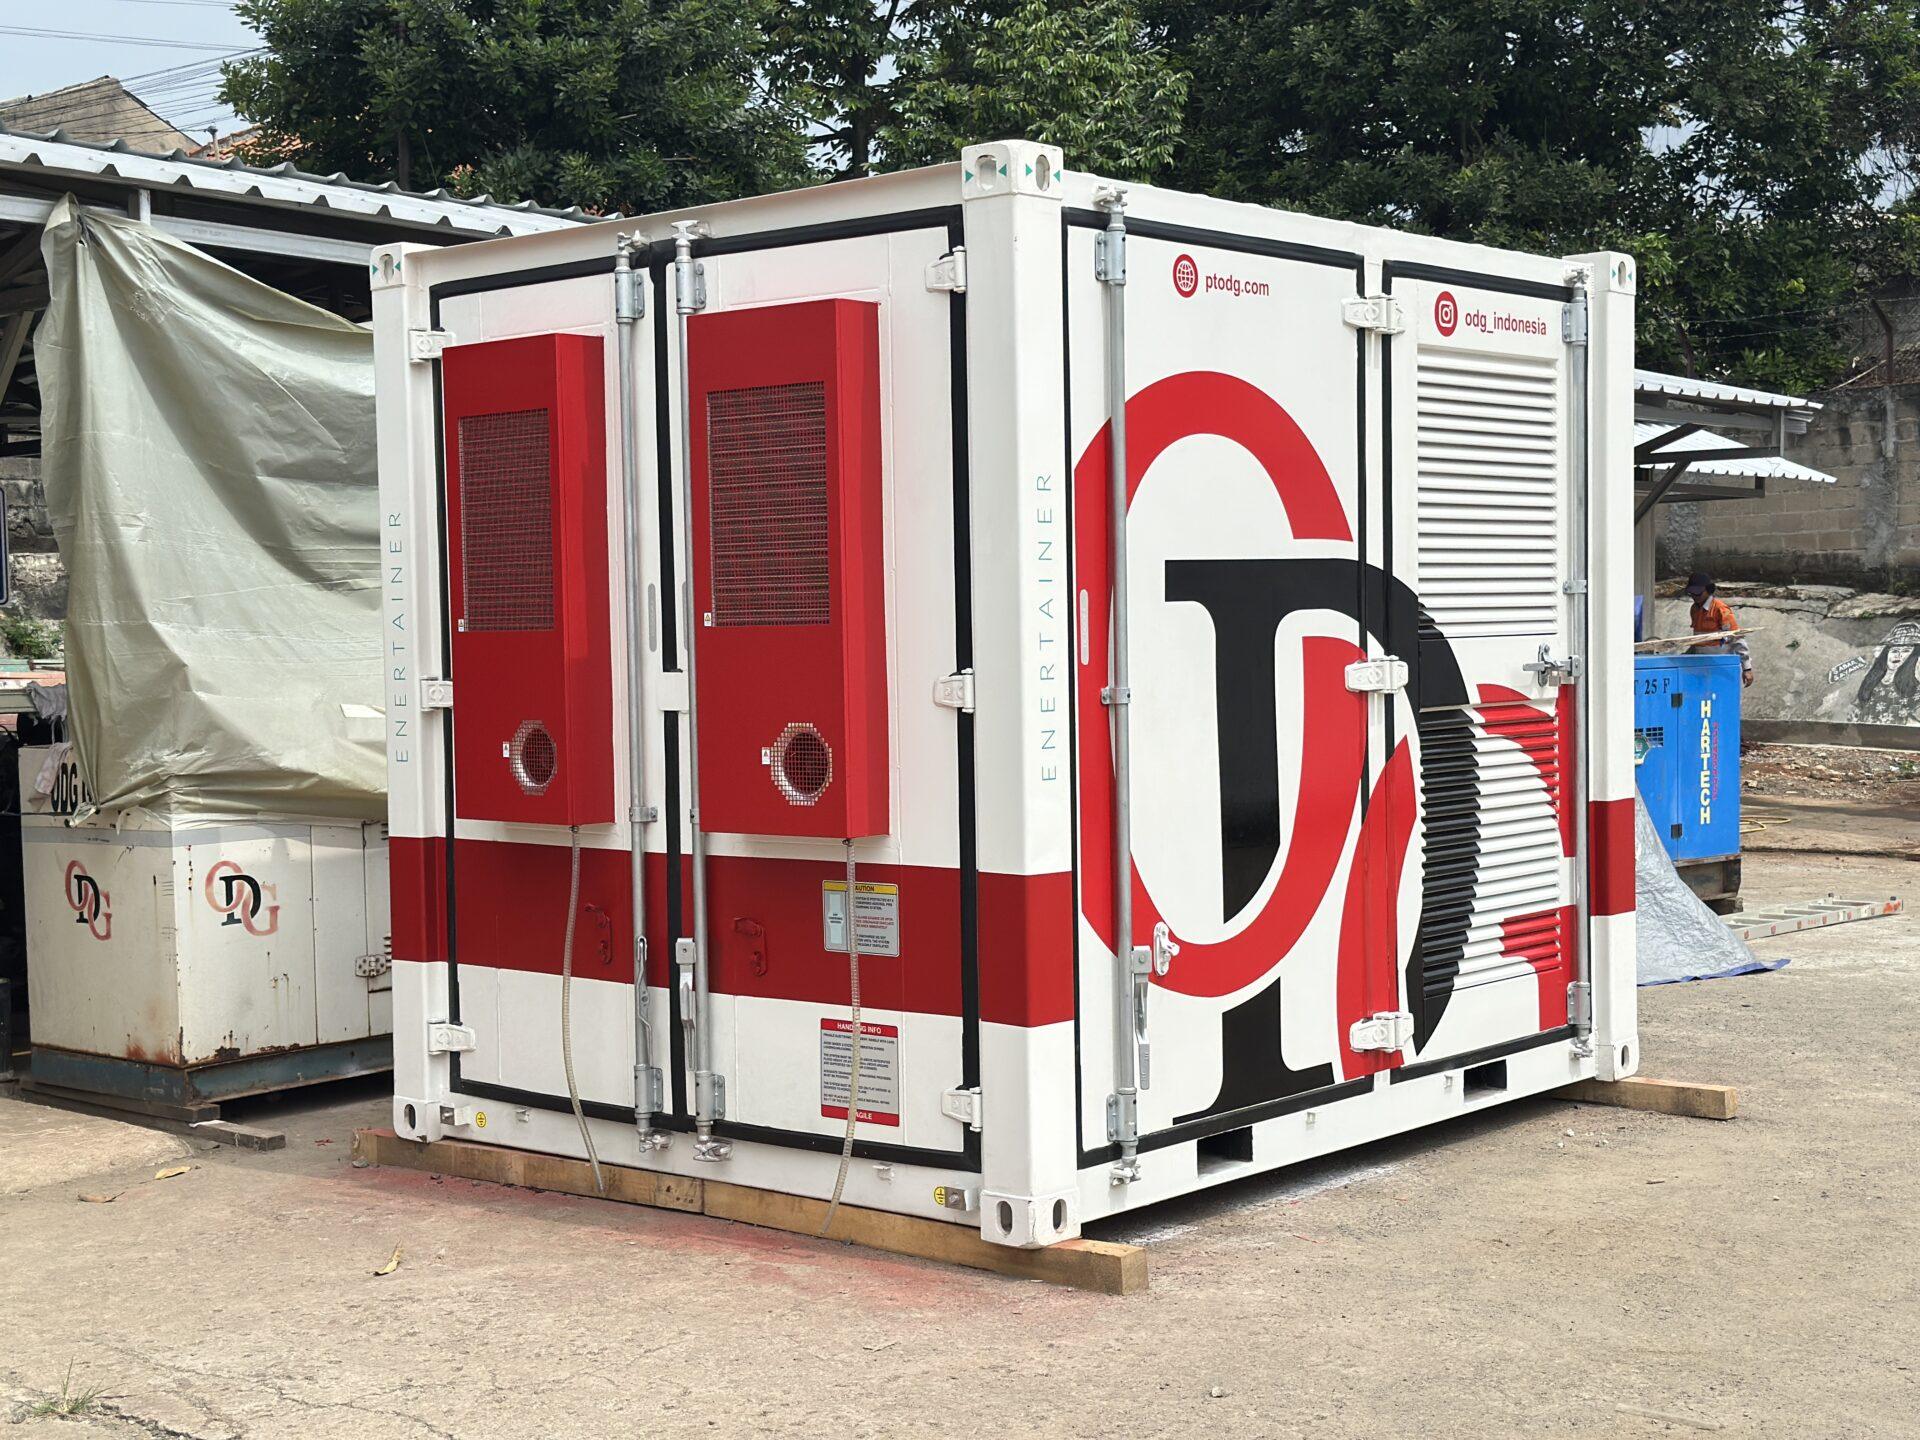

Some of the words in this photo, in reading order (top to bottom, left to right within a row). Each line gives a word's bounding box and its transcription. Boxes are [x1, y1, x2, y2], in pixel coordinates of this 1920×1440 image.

[1206, 273, 1269, 296] ptodg.com
[1465, 309, 1547, 335] odg_indonesia
[388, 513, 408, 763] ENERTAINER
[1037, 474, 1056, 781] ENERTAINER
[1644, 679, 1658, 695] 25
[1663, 678, 1670, 694] F
[1700, 700, 1711, 824] HARTECH
[868, 1026, 882, 1034] INFO
